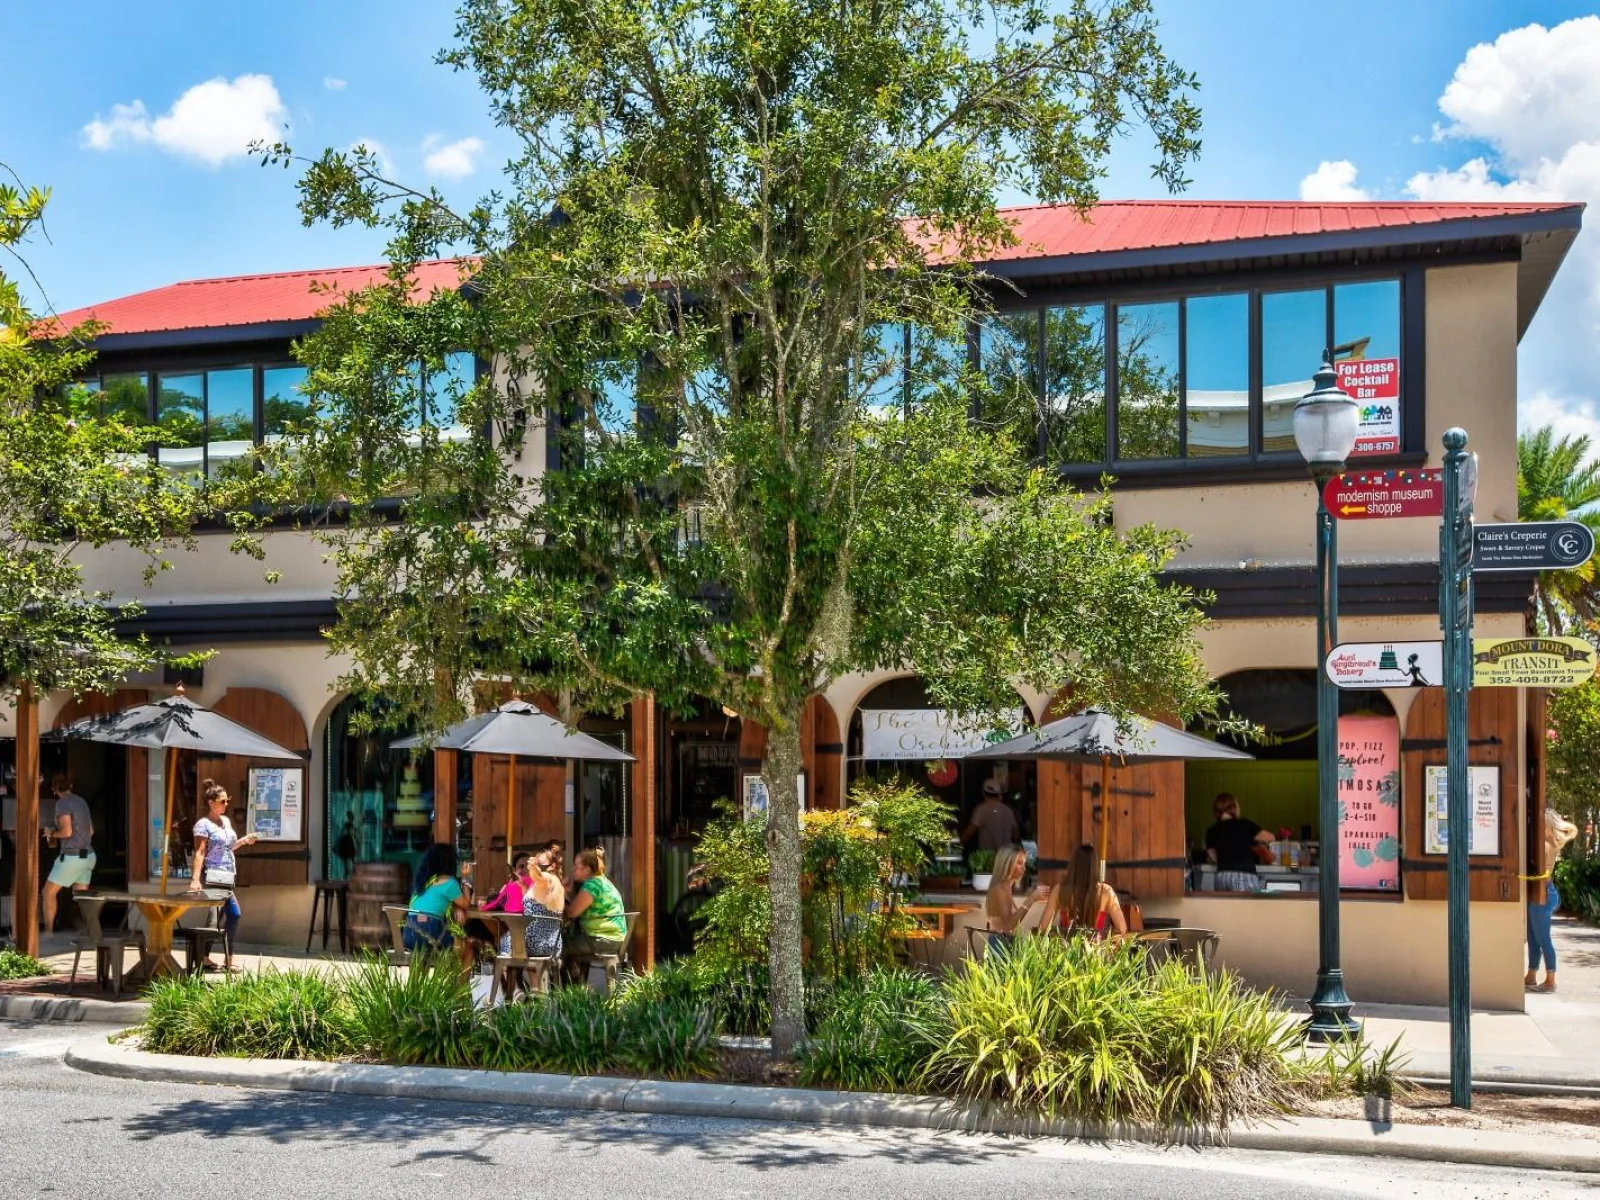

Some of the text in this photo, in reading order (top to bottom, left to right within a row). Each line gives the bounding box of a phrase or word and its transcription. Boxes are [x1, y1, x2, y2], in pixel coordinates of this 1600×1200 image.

[1339, 362, 1394, 376] For Lease
[1344, 374, 1389, 387] Cocktail
[1357, 387, 1376, 398] Bar
[1337, 488, 1433, 503] modernism museum
[1367, 502, 1402, 515] shoppe
[1478, 530, 1547, 541] Claire's Creperie
[1504, 543, 1524, 552] Savory
[1491, 640, 1570, 657] MOUNT DORA
[1501, 657, 1561, 669] TRANSIT
[1336, 668, 1364, 676] Bakery
[1489, 675, 1574, 684] 352-409-8722
[1364, 741, 1383, 750] FIZZ
[1339, 779, 1392, 791] IMOSAS
[1352, 802, 1373, 810] TO GO
[1344, 831, 1389, 839] SPARKLING
